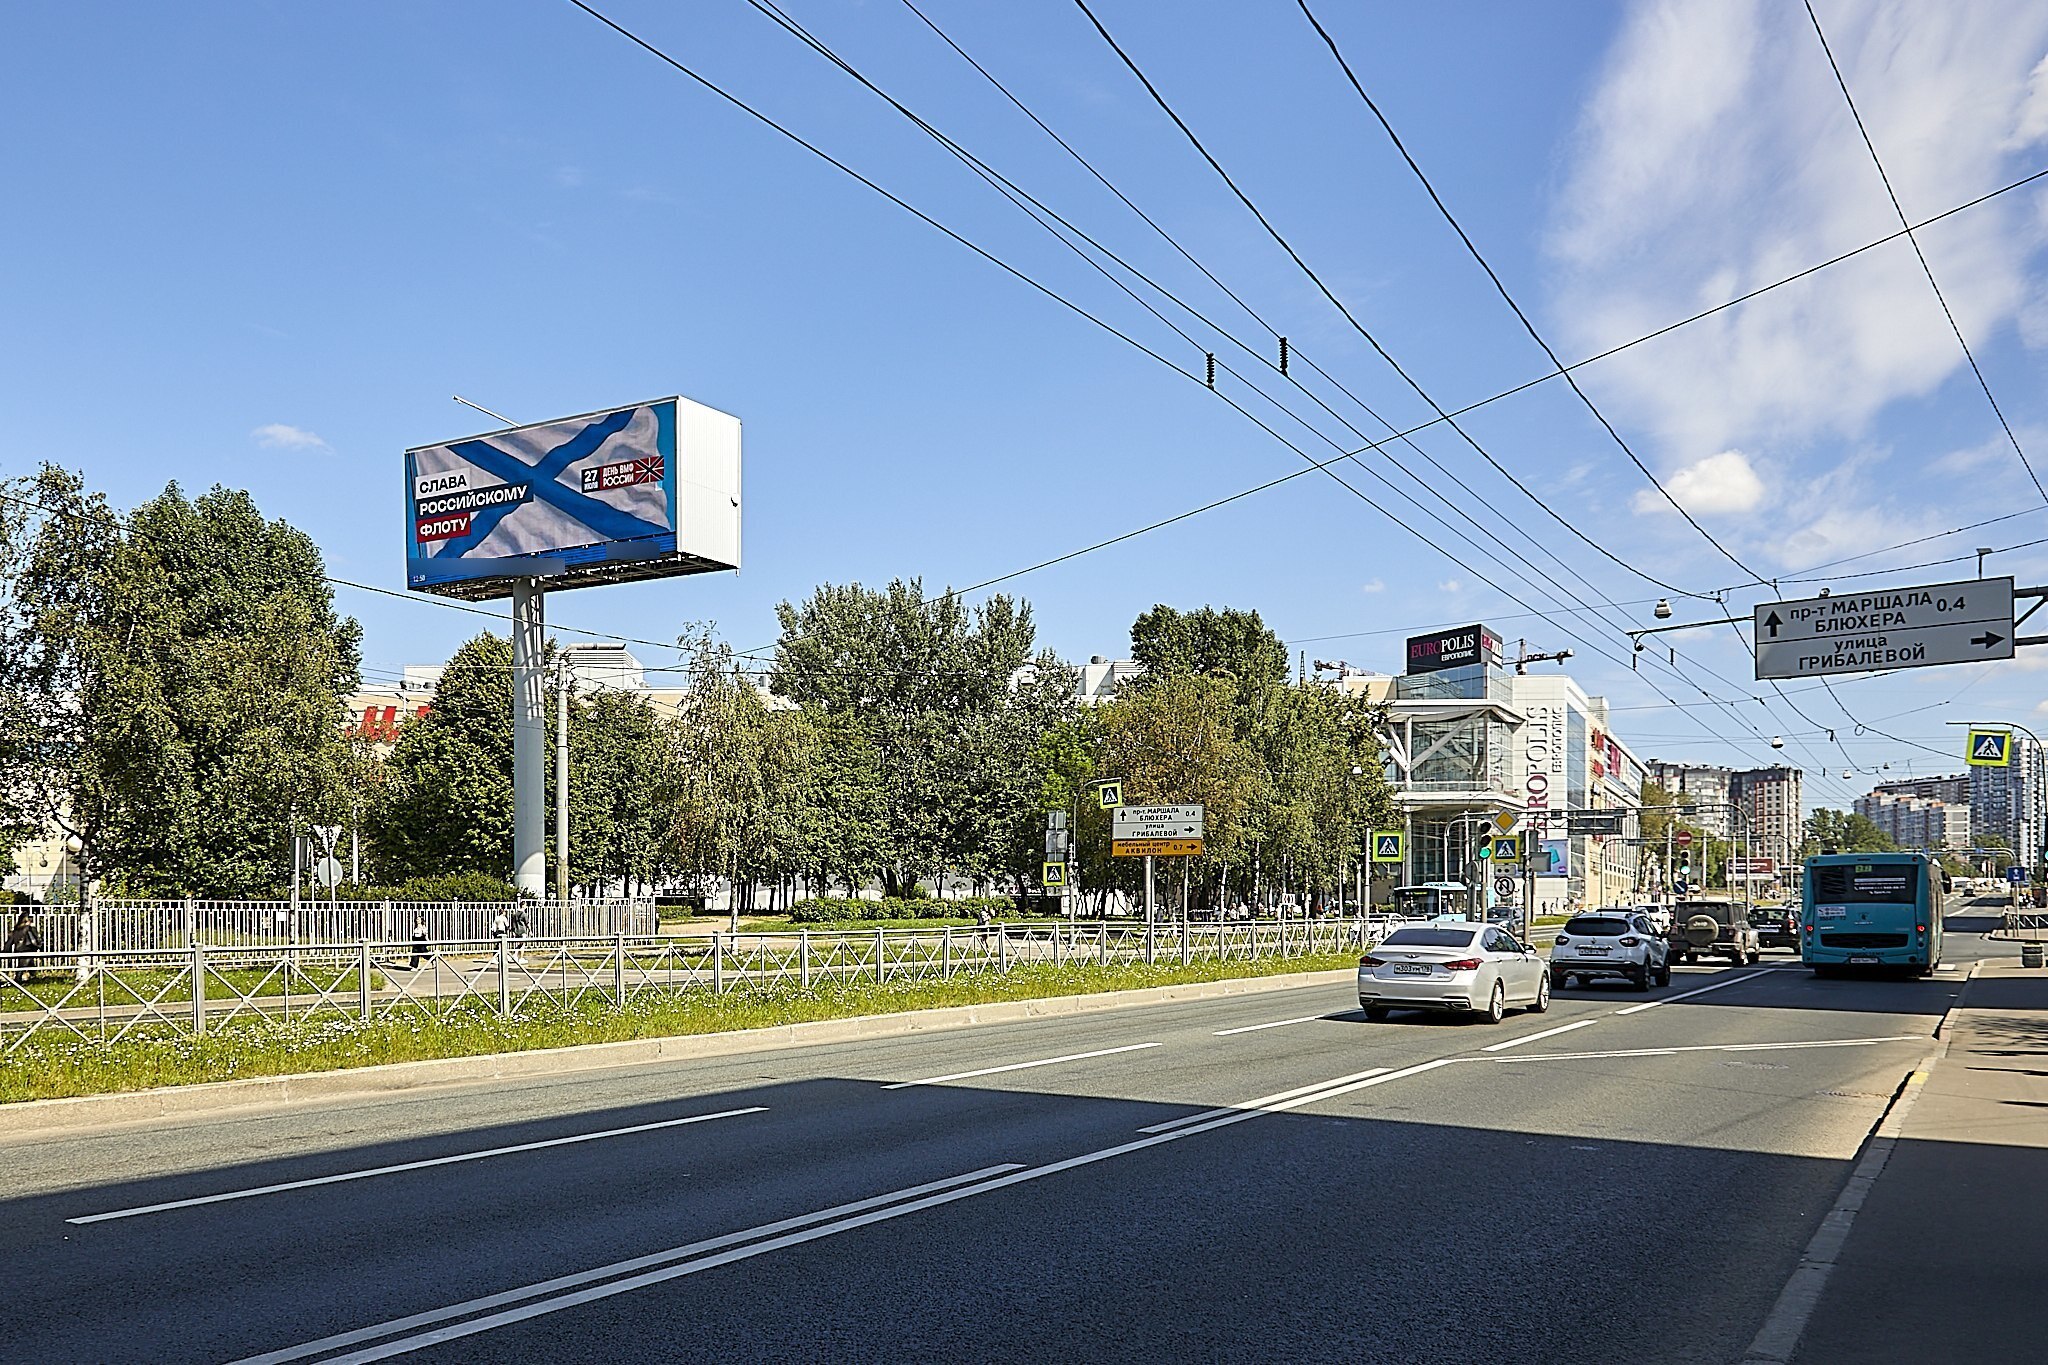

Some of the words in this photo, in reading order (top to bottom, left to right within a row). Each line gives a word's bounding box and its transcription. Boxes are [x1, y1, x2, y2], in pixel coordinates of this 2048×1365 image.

[584, 469, 598, 483] 27
[603, 466, 619, 478] ДЕНЬ
[619, 462, 635, 474] ВМФ
[420, 475, 467, 493] СЛАВА
[603, 472, 634, 487] РОССИИ
[420, 485, 528, 516] РОССИЙСКОМУ
[420, 518, 468, 536] ФЛОТУ
[1790, 606, 1827, 621] пр-т
[1831, 591, 1933, 615] МАРШАЛА
[1815, 611, 1906, 633] БЛЮХЕРА
[1411, 634, 1475, 659] EUROPOLIS
[1834, 636, 1888, 653] улица
[1441, 650, 1475, 662] ЕВРОПОЛИС
[1799, 642, 1925, 670] ГРИБАЛЕВОЙ
[1552, 706, 1562, 773] ЕВРОПОЛИС
[1132, 829, 1178, 837] ГРИБАЛЕВОЙ
